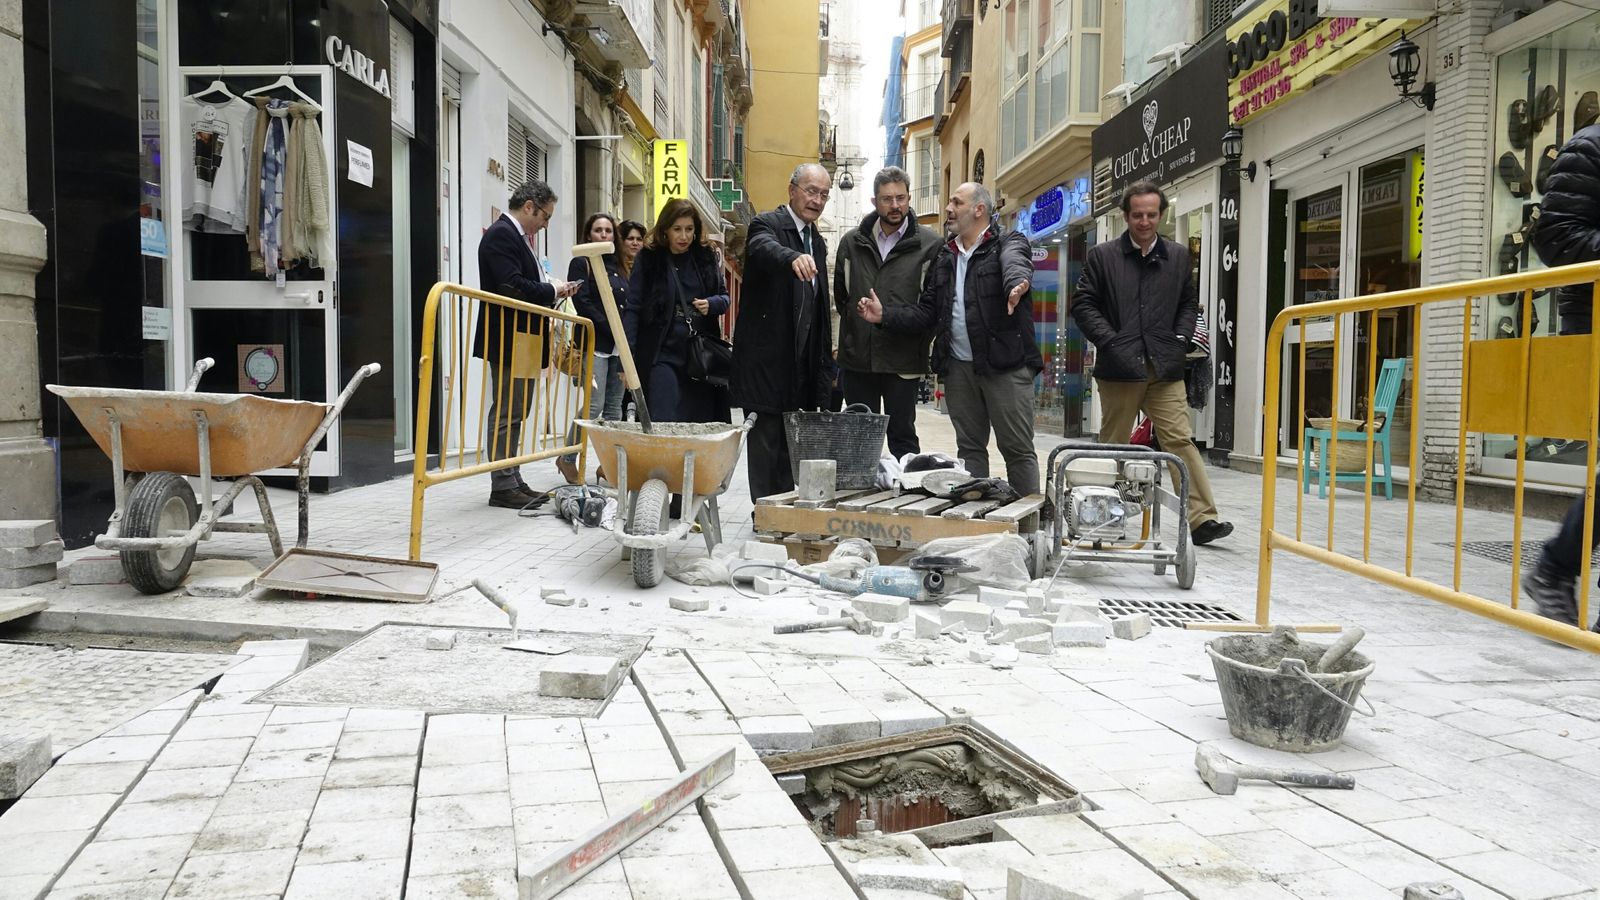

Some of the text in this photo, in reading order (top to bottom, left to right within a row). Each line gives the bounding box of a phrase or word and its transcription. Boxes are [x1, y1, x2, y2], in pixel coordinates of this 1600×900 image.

[325, 35, 391, 99] CARLA
[1226, 10, 1287, 79] COCO
[1240, 57, 1282, 96] NATURAL
[1289, 38, 1308, 67] SPA
[1315, 33, 1325, 49] &
[1443, 52, 1454, 69] 35
[661, 143, 681, 200] FARM
[1114, 116, 1191, 179] CHIC & CHEAP
[1223, 244, 1238, 271] 6€
[1219, 298, 1233, 348] 8€
[827, 515, 912, 540] COSMOS
